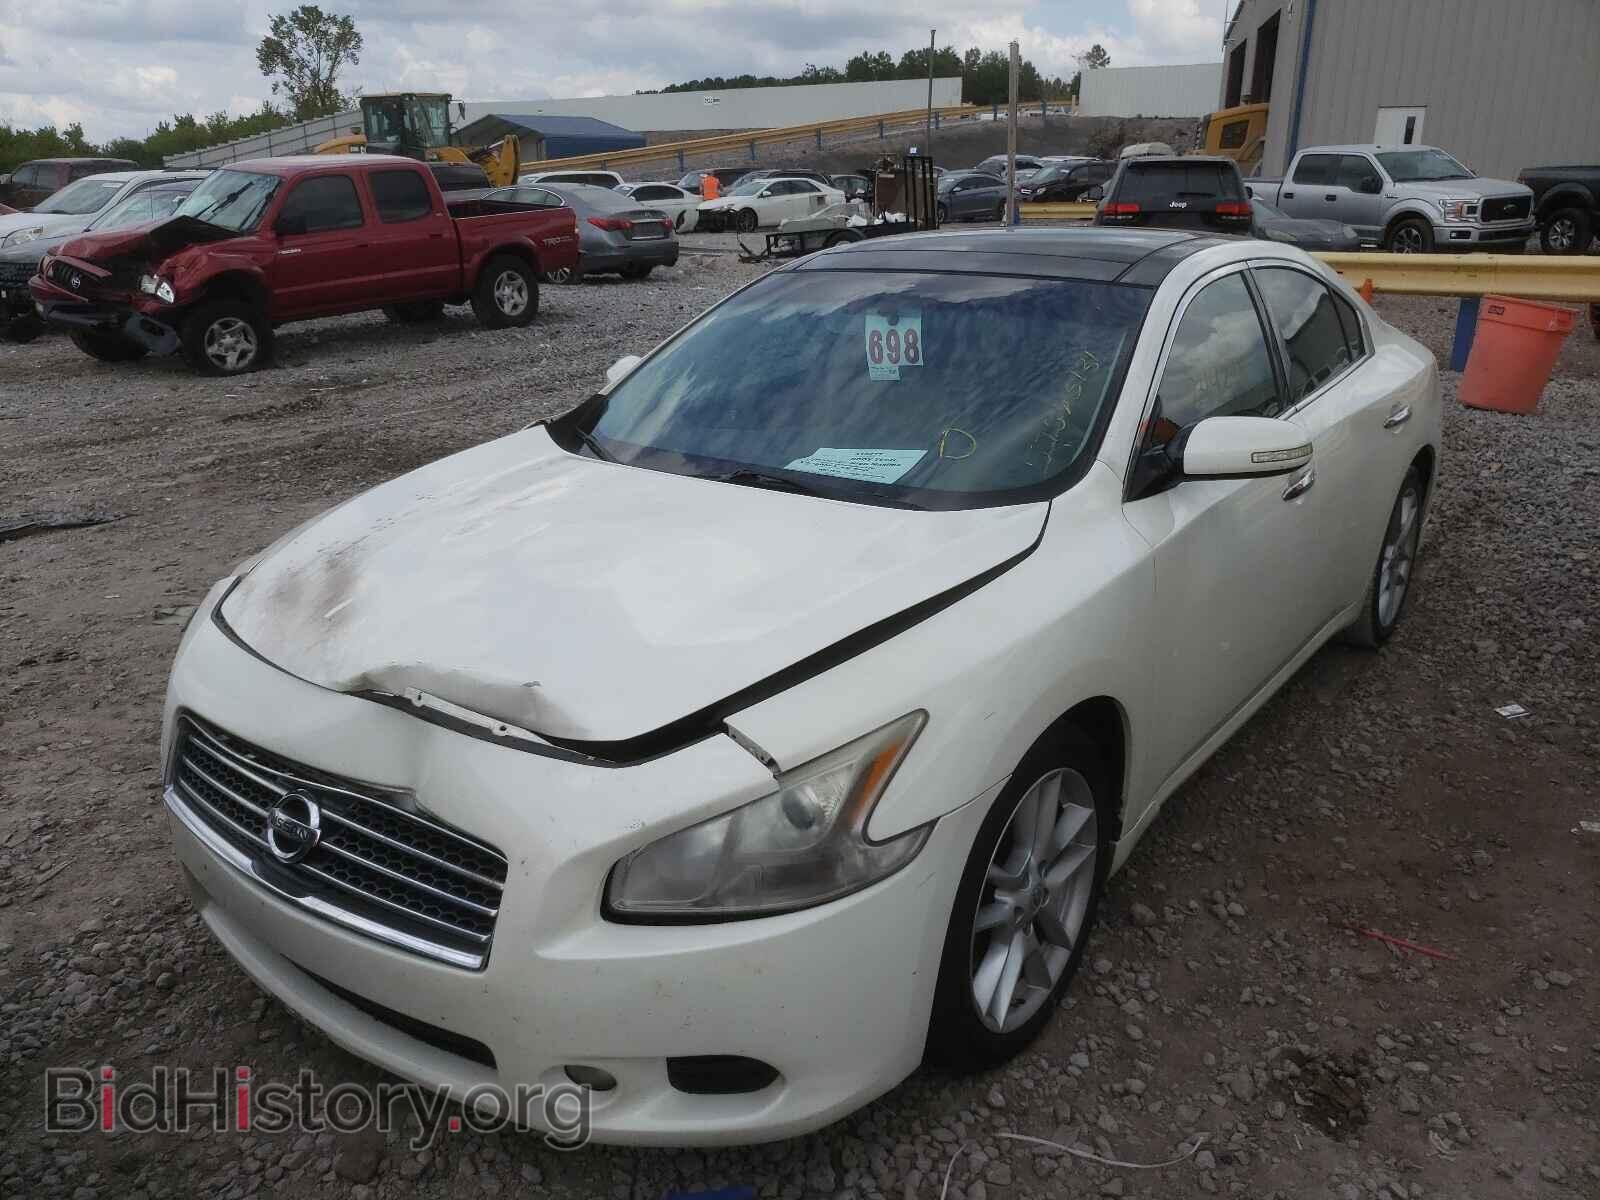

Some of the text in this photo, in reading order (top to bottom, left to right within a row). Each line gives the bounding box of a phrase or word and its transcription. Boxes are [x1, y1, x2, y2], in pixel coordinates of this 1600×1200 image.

[1169, 201, 1188, 209] Jeep
[868, 328, 920, 364] 698
[939, 427, 977, 459] D
